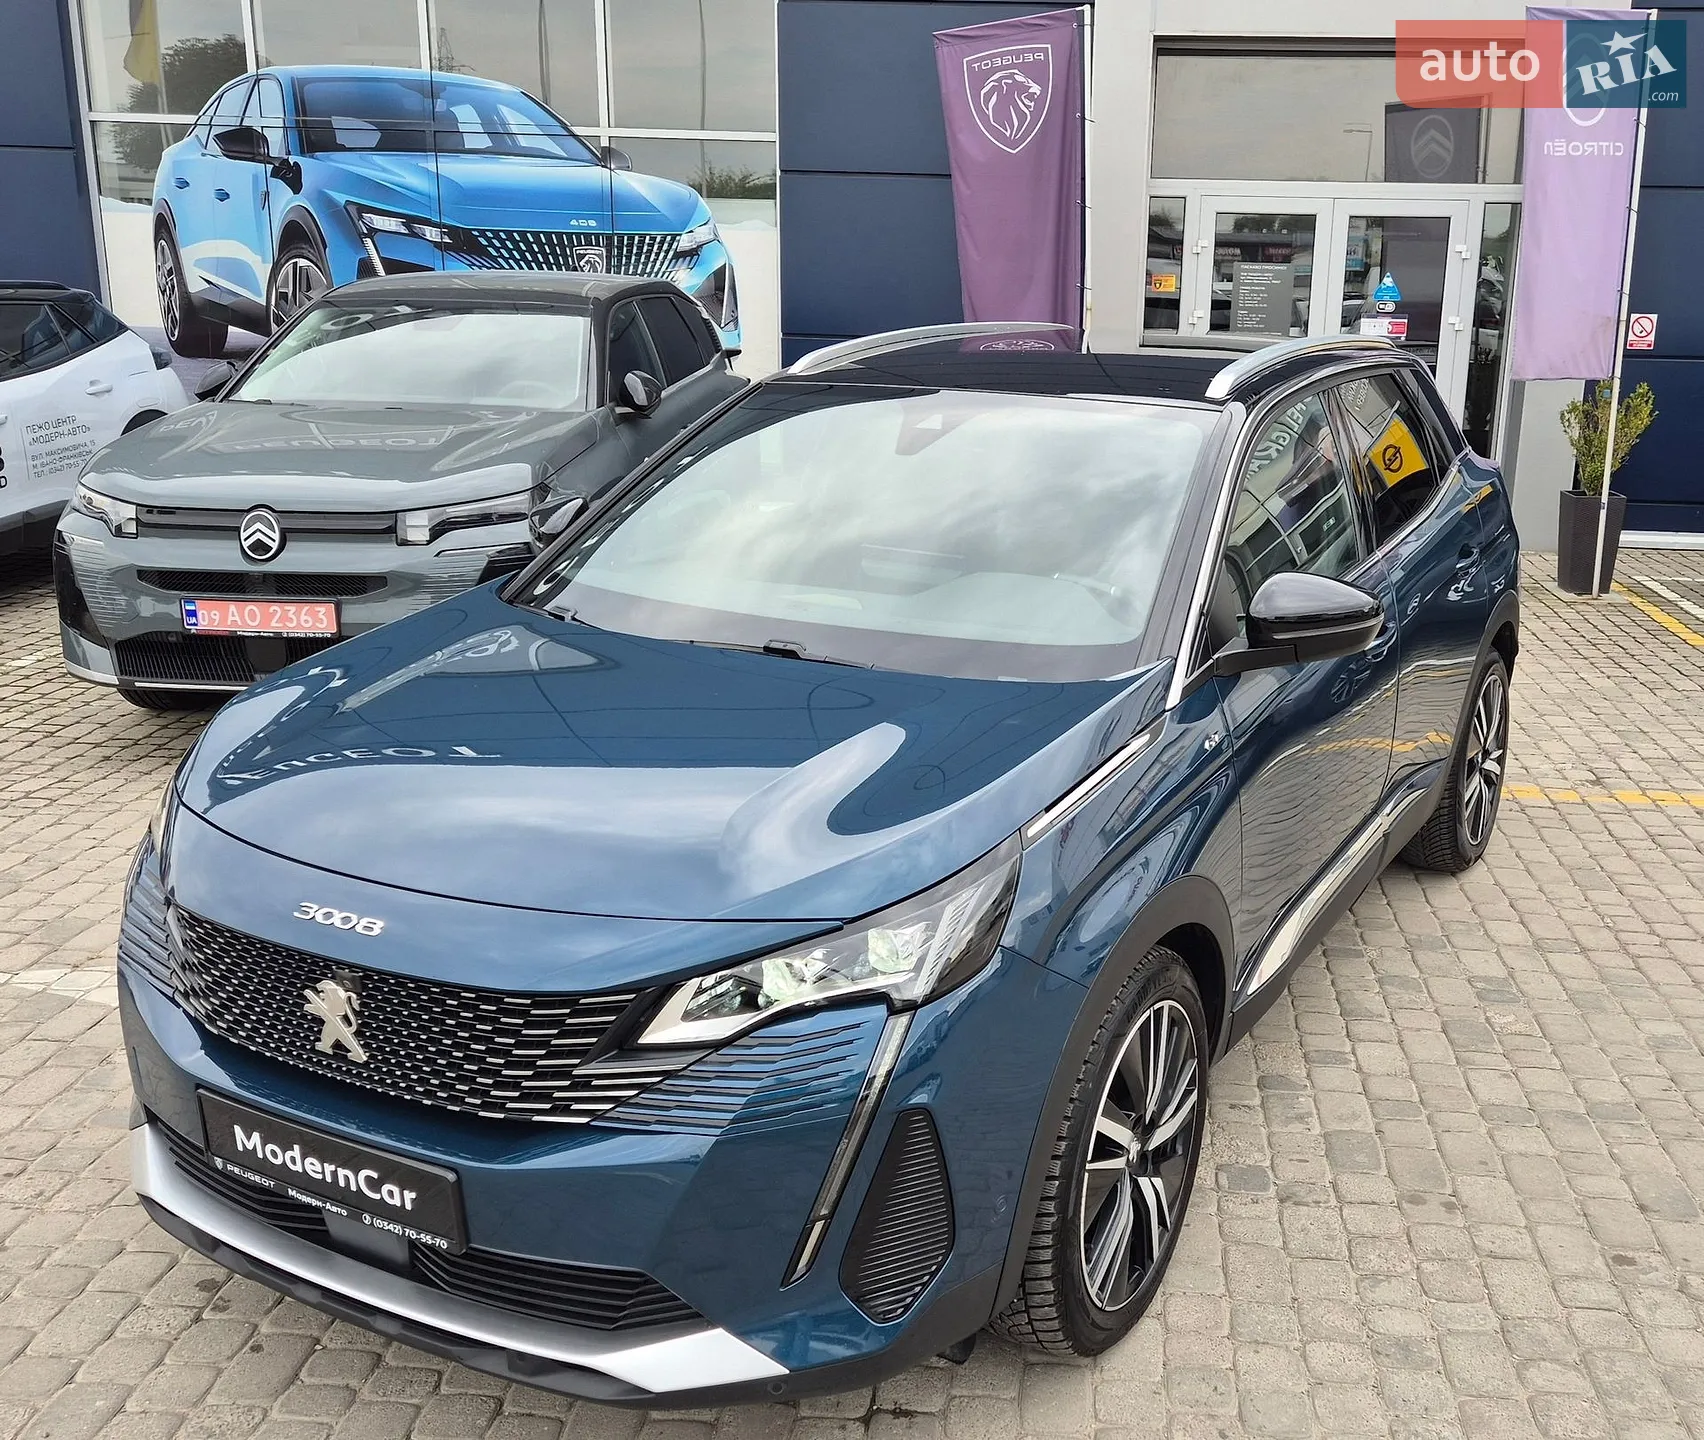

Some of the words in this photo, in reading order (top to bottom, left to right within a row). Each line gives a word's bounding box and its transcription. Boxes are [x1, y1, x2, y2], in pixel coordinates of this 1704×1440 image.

[26, 421, 50, 435] ПЕЖО
[51, 415, 77, 429] ЦЕНТР
[200, 610, 220, 626] 09
[227, 604, 261, 626] AO
[269, 606, 328, 628] 2363
[293, 902, 384, 936] 3008
[233, 1124, 417, 1211] ModernCar
[227, 1164, 275, 1188] PEUGEOT
[287, 1187, 348, 1216] Модерн-Авто
[373, 1217, 402, 1236] (0342)
[404, 1227, 448, 1250] 70-55-70
